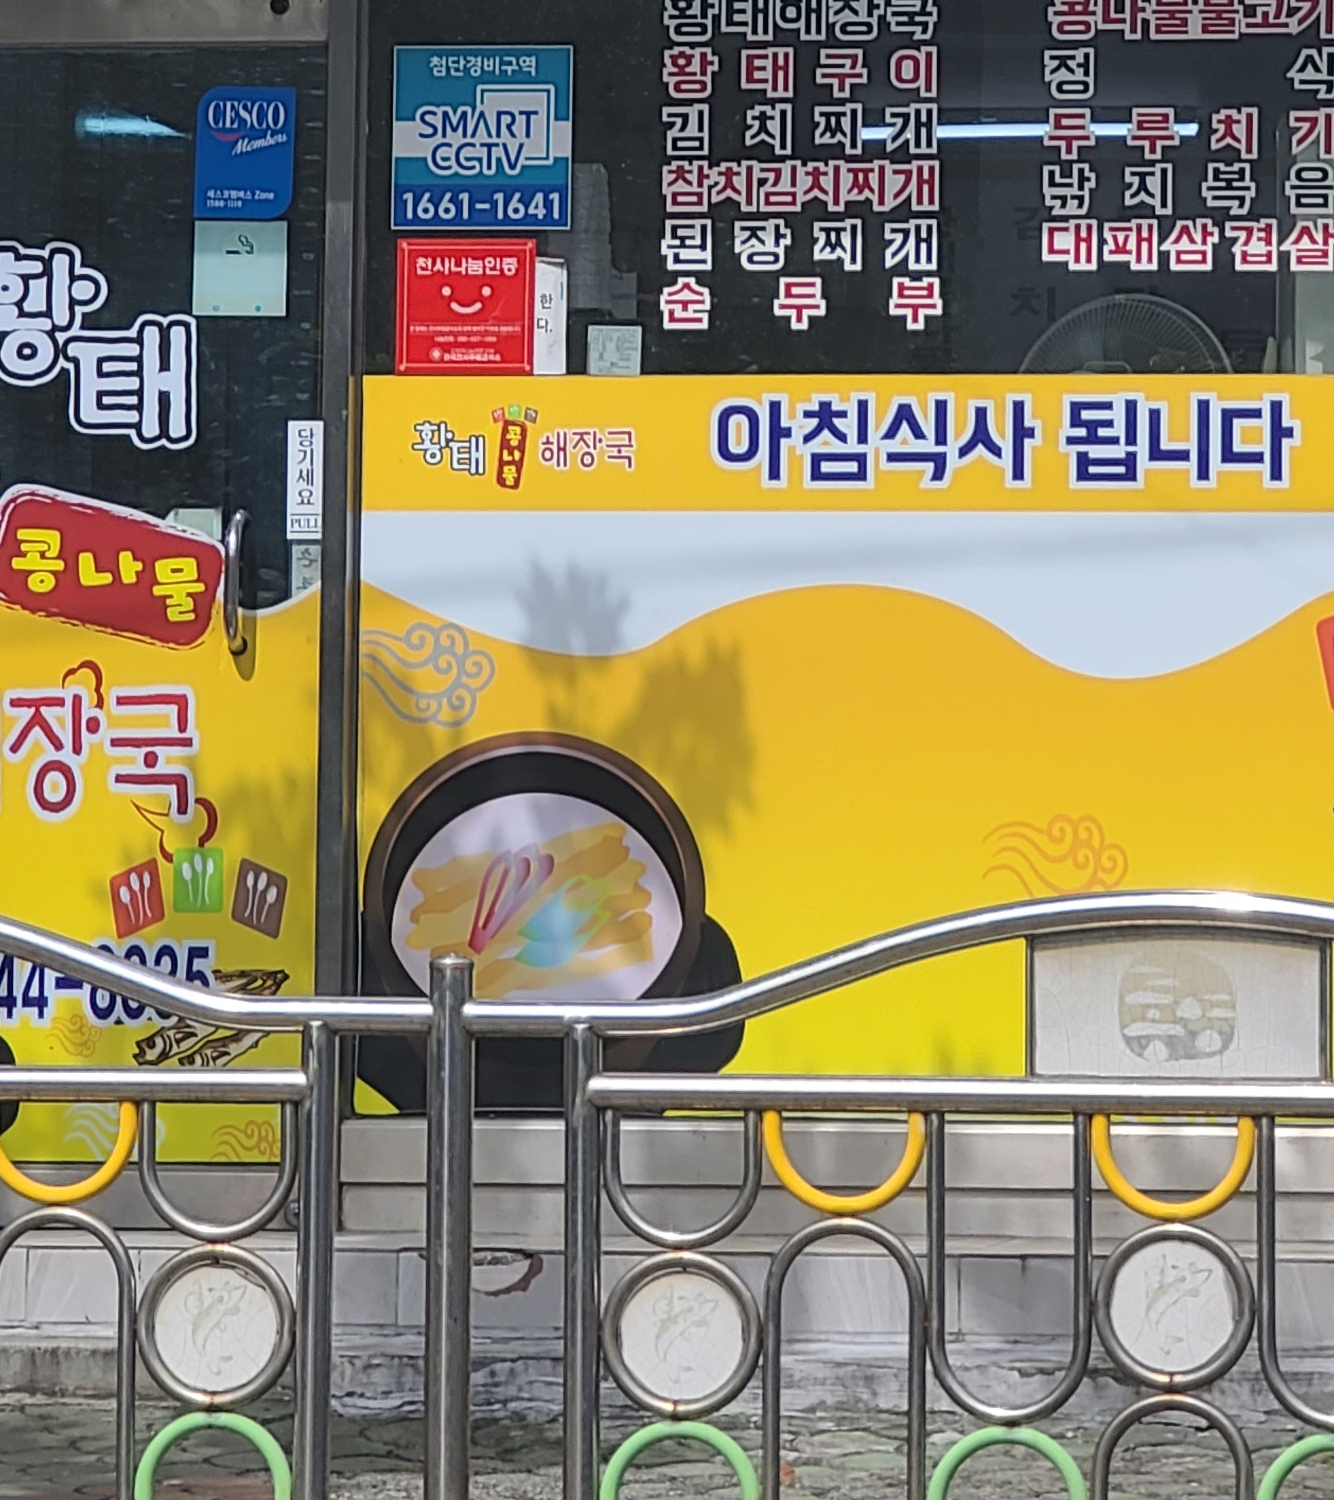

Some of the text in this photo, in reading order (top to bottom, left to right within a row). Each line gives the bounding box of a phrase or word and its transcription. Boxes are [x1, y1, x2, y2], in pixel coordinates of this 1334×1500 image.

[429, 55, 537, 77] 첨단경비구역
[207, 100, 286, 131] CESCO
[418, 110, 539, 139] SMART
[232, 129, 288, 156] Members
[430, 142, 525, 171] CCTV
[254, 190, 275, 200] Zone
[402, 191, 560, 220] 1661-1641
[415, 257, 519, 276] 천사나눔인증
[411, 420, 635, 487] 황태 콩나물 해장국
[710, 392, 1300, 491] 아침식사 됩니다
[296, 427, 316, 506] 당기세요
[10, 527, 208, 623] 콩나물
